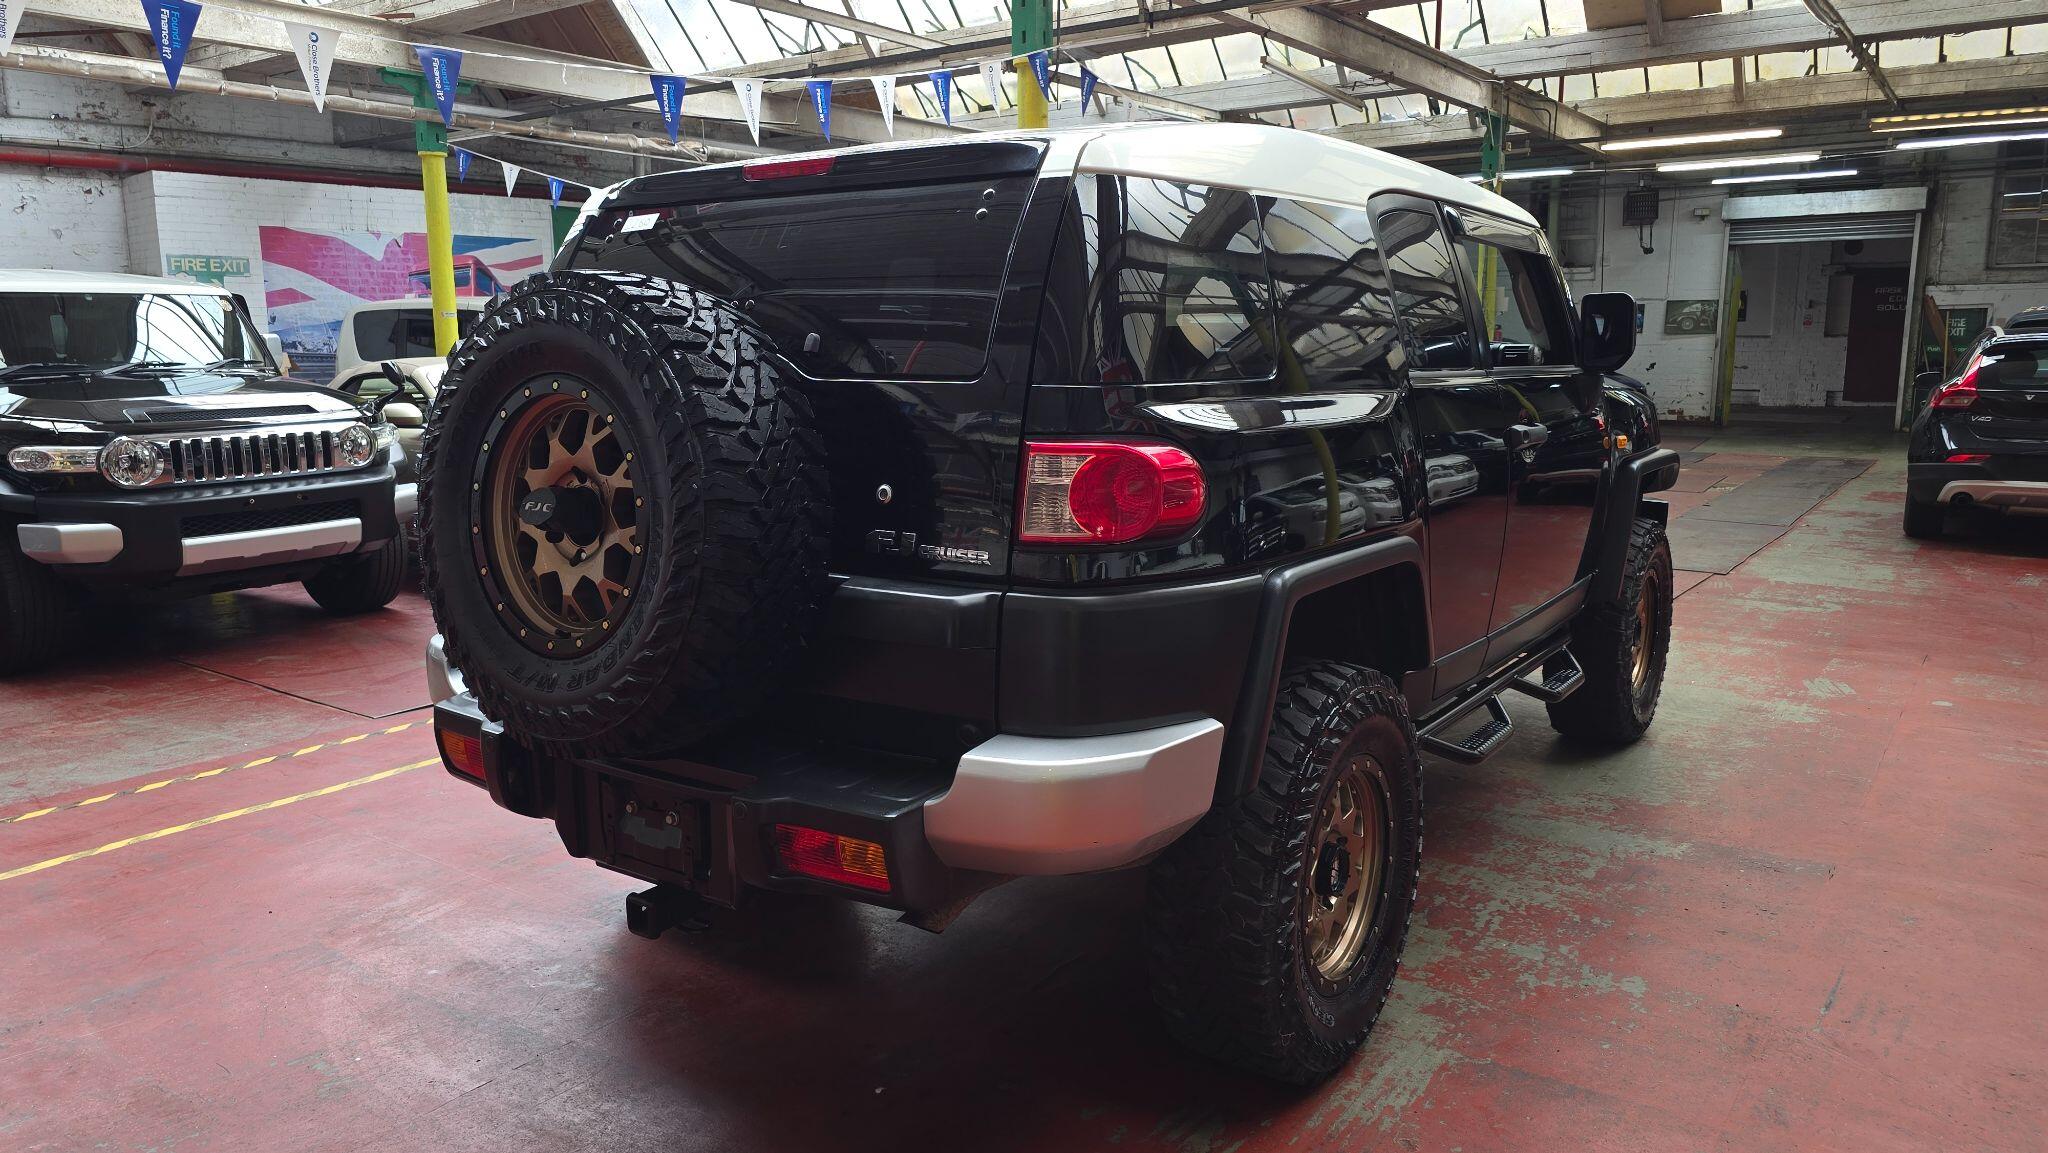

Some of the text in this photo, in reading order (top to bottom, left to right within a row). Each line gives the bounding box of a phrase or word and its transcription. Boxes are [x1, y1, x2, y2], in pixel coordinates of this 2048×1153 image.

[161, 8, 172, 59] Finance it?
[171, 11, 180, 40] Found
[432, 57, 445, 101] Finance it?
[440, 59, 449, 86] Found
[170, 257, 248, 273] FIRE EXIT
[523, 501, 552, 513] FJC
[867, 529, 990, 562] FJ CRUISER
